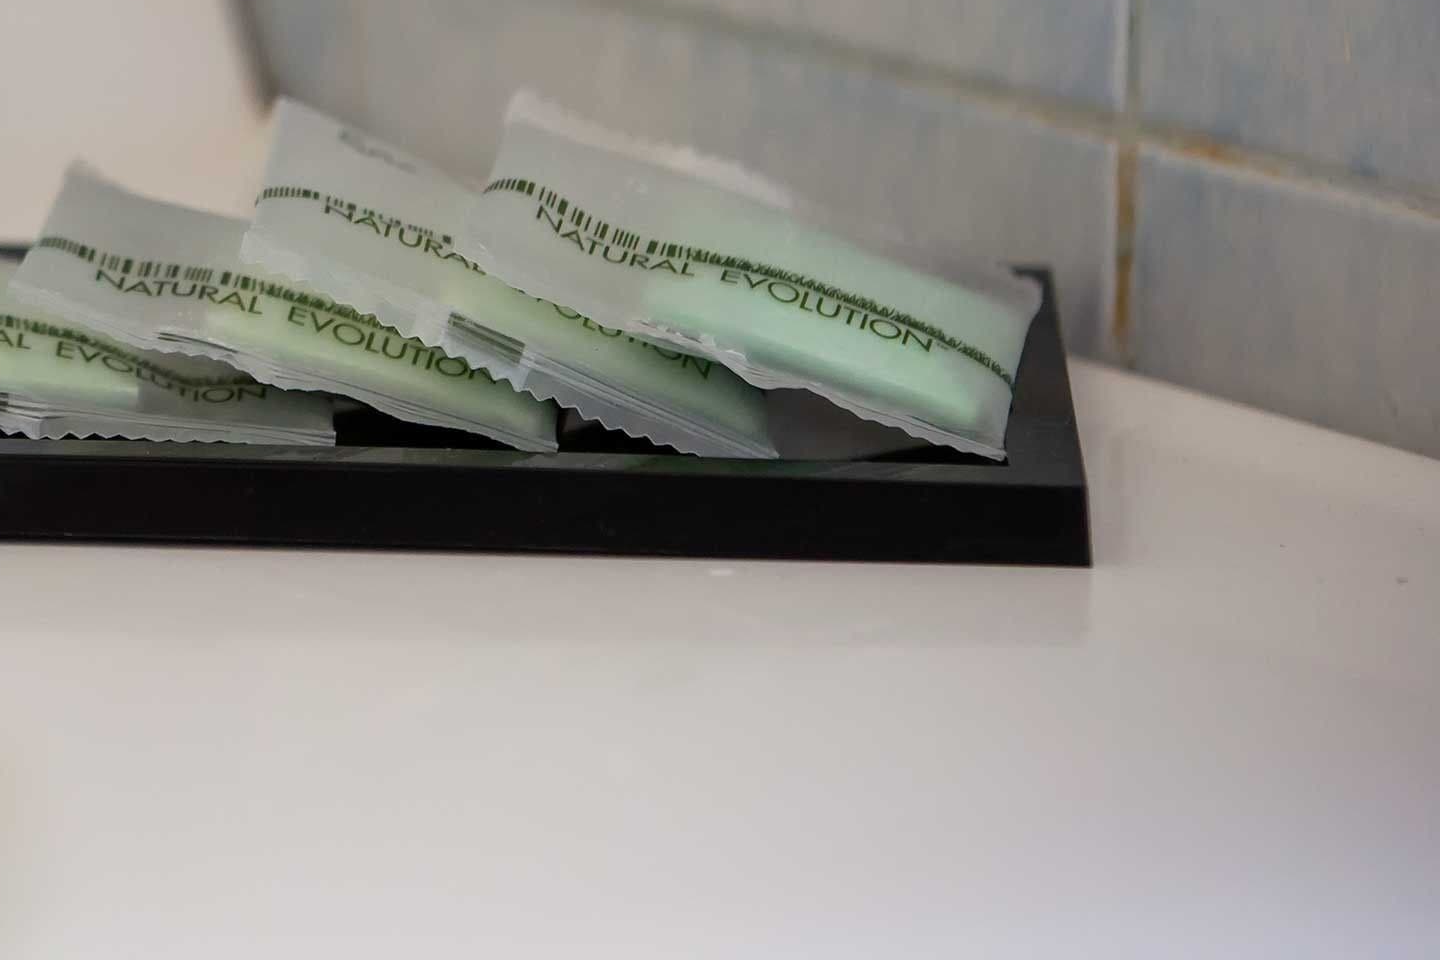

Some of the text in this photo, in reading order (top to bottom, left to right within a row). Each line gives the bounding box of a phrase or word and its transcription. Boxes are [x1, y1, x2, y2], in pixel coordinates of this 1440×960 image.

[323, 204, 487, 275] NATURAL
[95, 269, 264, 315] NATURAL
[536, 205, 933, 352] NATURAL EVOLUTION
[55, 339, 268, 403] EVOLUTION
